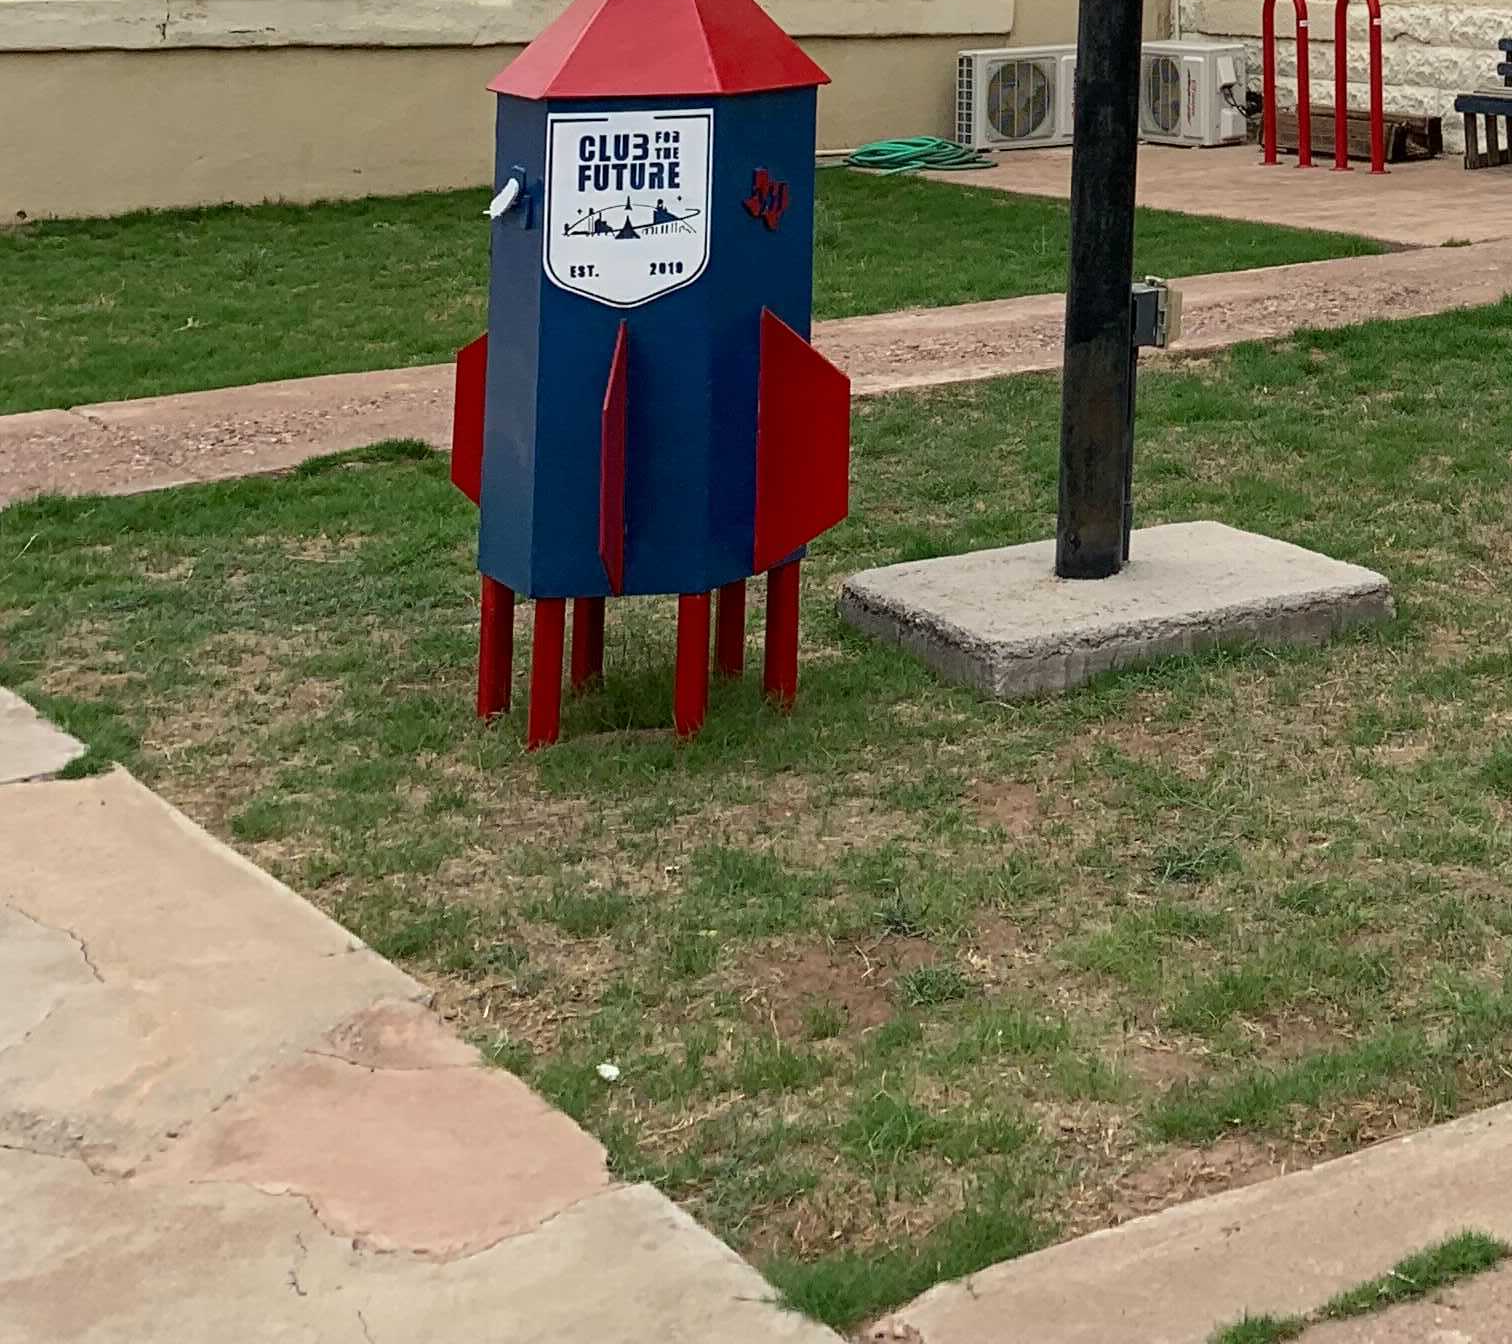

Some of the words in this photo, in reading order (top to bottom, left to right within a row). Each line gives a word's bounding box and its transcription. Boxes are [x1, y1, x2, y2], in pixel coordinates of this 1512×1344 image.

[654, 131, 681, 144] FOR
[579, 133, 650, 162] CLUB
[654, 147, 680, 160] THE
[578, 161, 681, 192] FUTURE
[570, 265, 600, 278] EST.
